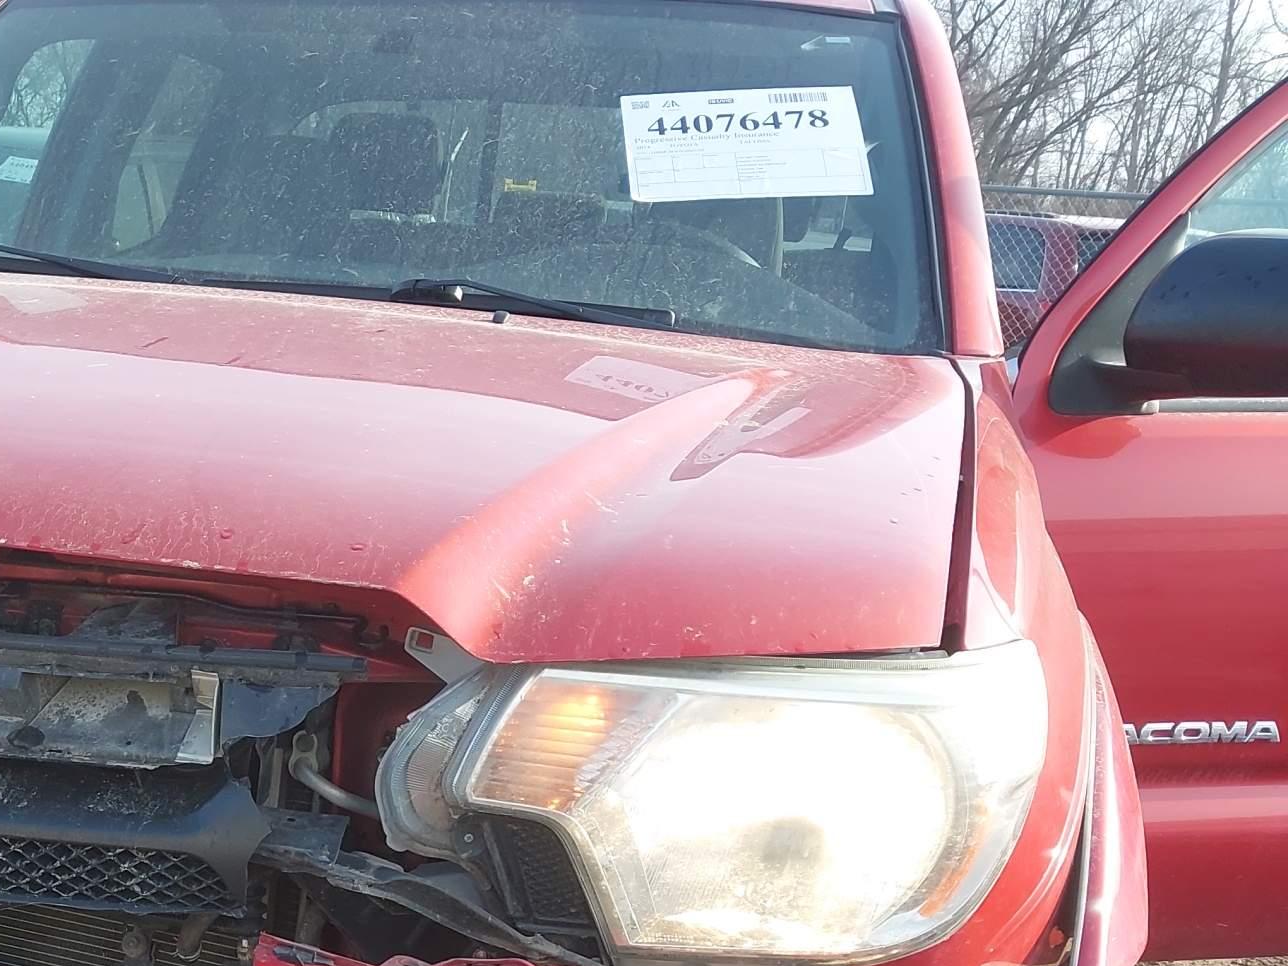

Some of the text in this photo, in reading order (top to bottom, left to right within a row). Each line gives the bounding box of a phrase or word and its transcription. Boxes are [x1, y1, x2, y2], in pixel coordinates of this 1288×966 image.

[648, 109, 830, 135] 44076478
[634, 136, 688, 144] Progressive
[734, 131, 780, 139] Insurance
